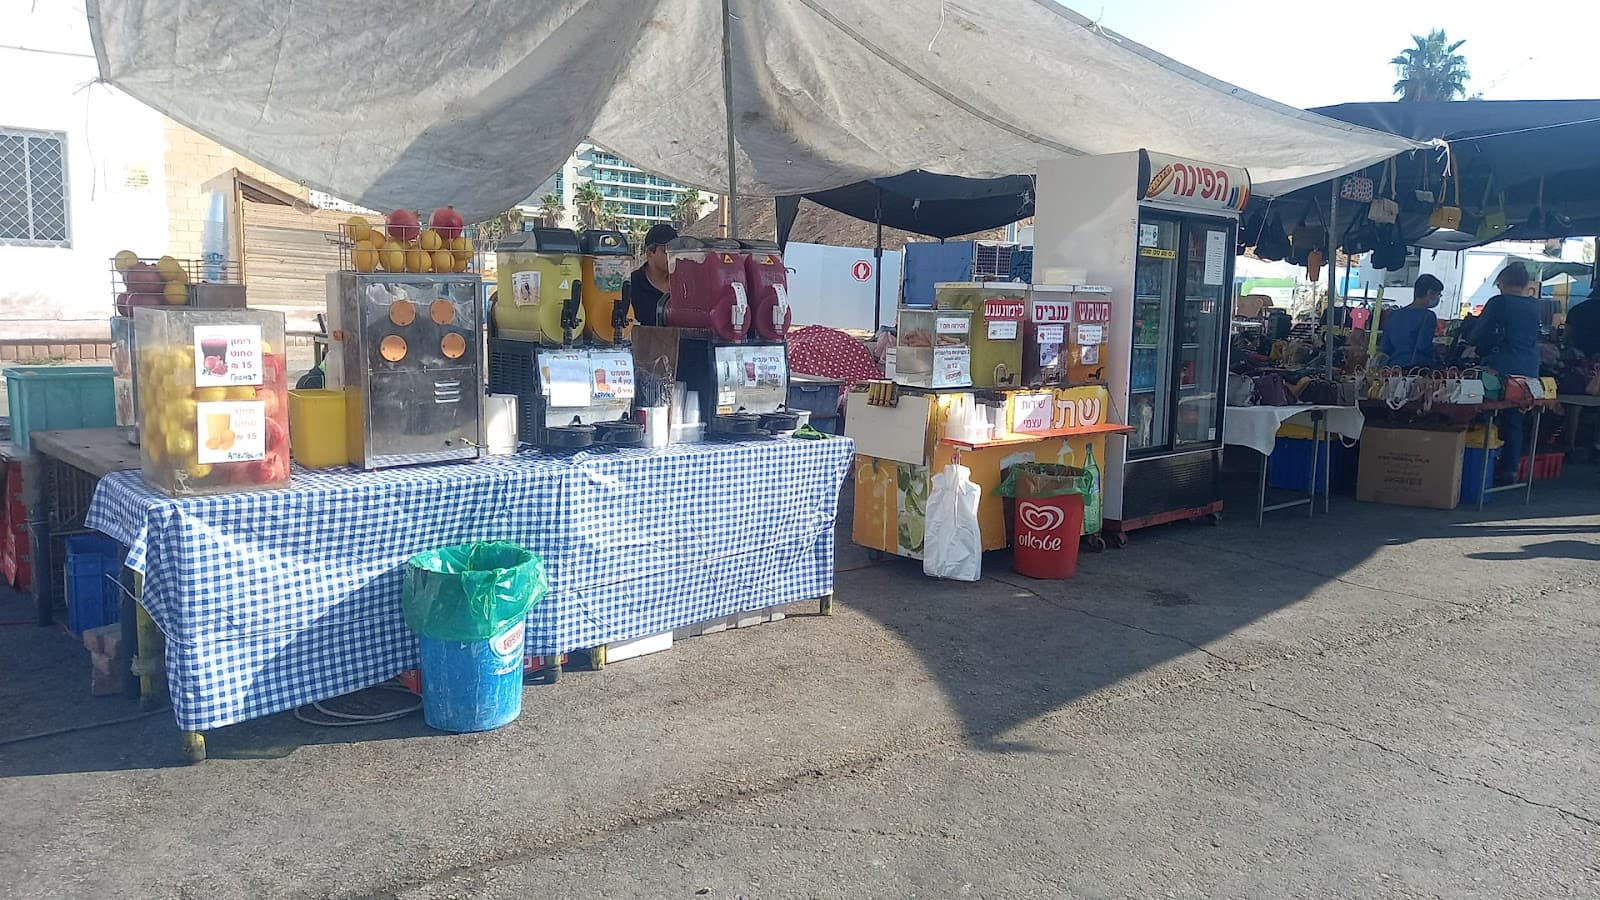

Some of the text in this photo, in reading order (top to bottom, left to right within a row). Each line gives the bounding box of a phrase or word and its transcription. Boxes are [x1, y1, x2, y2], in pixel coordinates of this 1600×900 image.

[1173, 163, 1229, 201] הפינה
[984, 303, 1024, 317] לימונענע
[1035, 305, 1069, 321] ענבים
[1079, 303, 1109, 321] משמש
[242, 361, 252, 369] 15
[1022, 399, 1046, 410] שירות
[1023, 418, 1042, 428] עצמי
[1018, 531, 1062, 551] שטראוס
